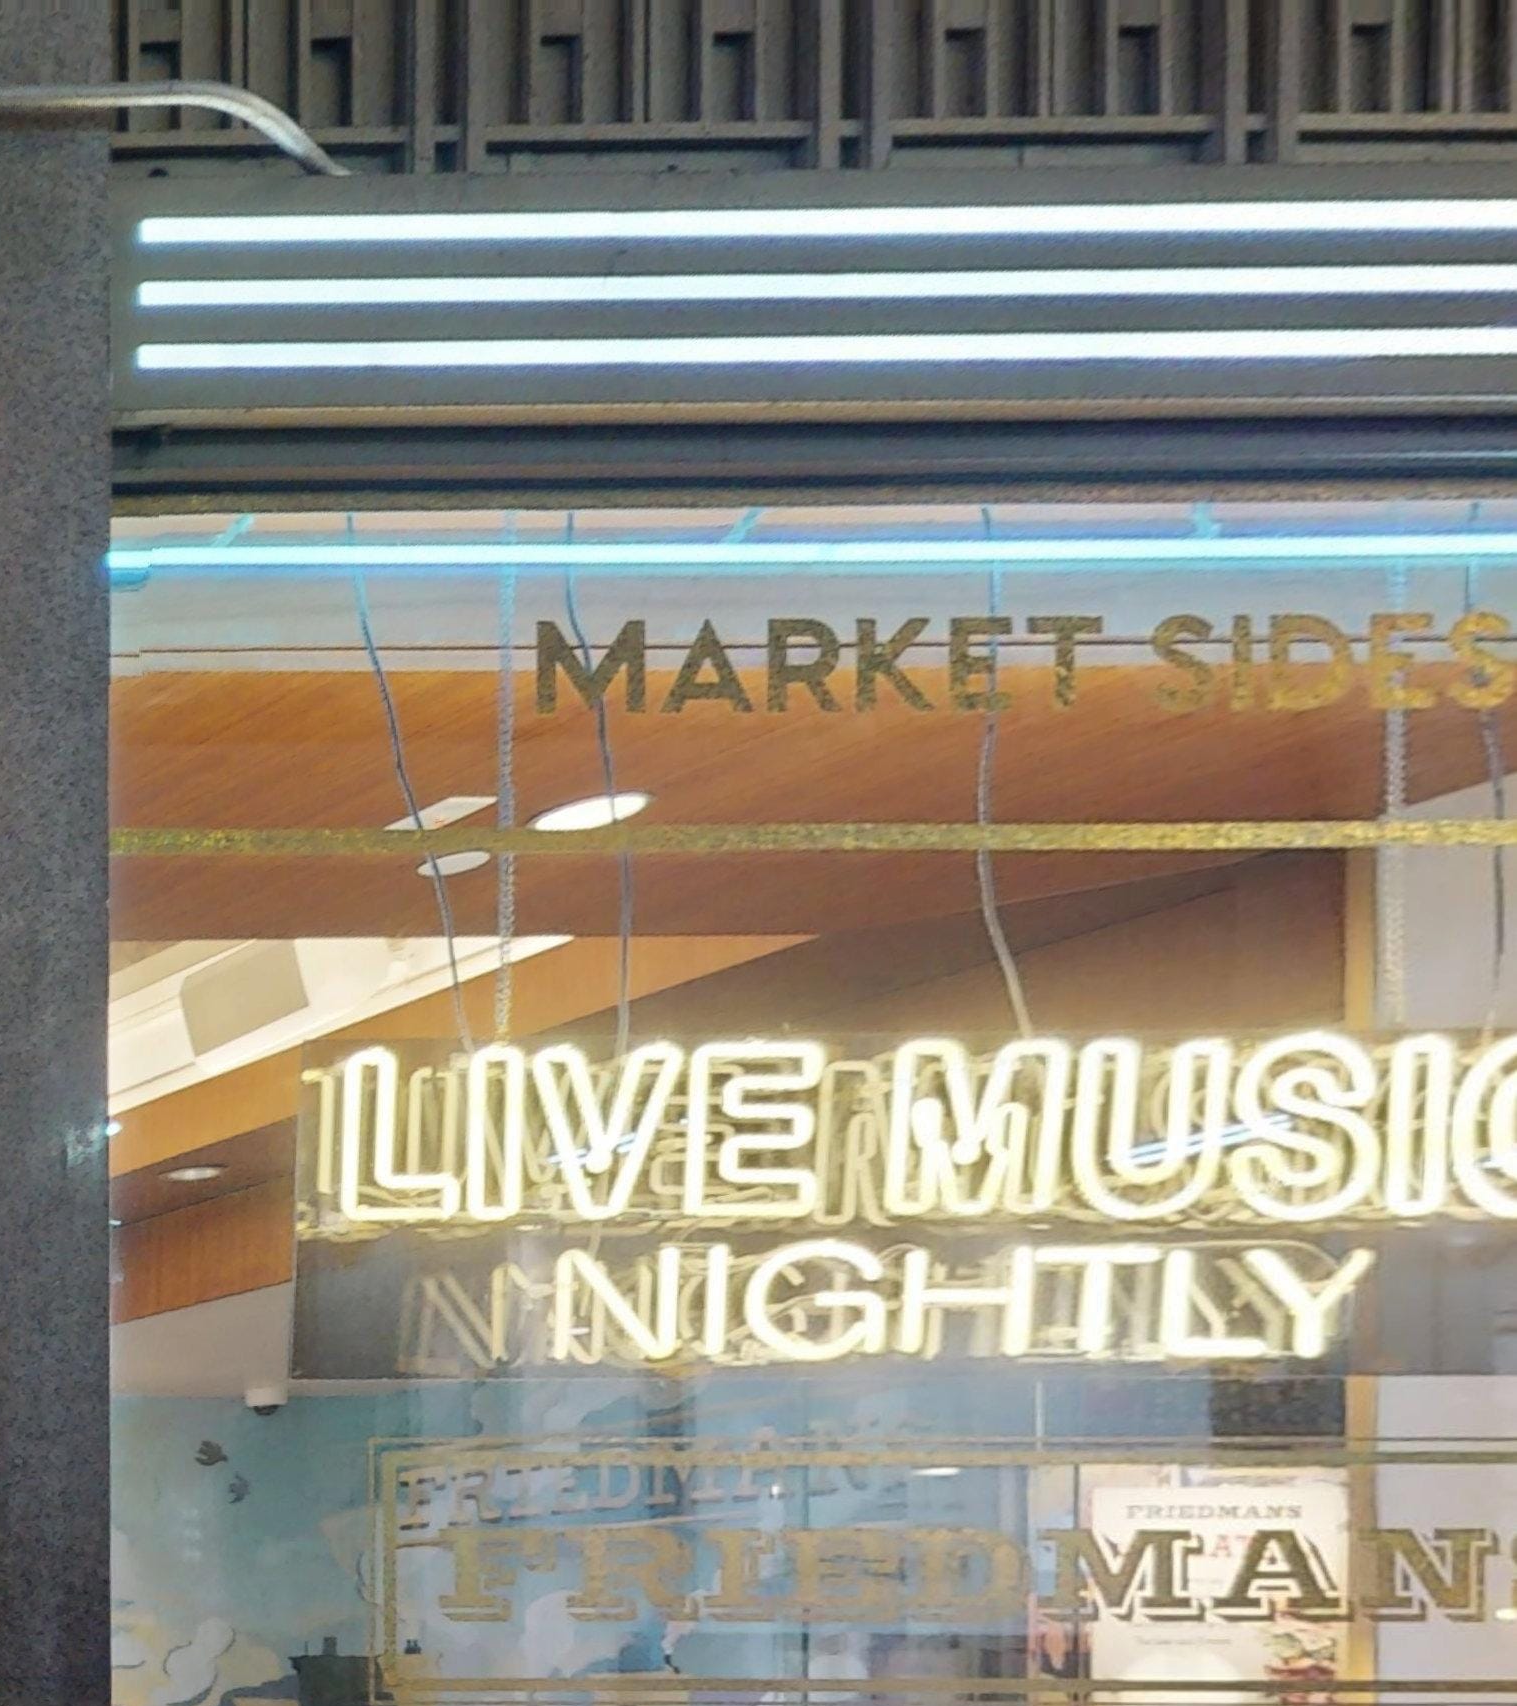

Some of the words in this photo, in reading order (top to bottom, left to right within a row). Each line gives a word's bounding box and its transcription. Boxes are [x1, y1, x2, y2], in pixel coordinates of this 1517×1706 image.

[533, 613, 1104, 715] MARKET
[1150, 611, 1515, 712] SIDES
[340, 1038, 826, 1222] LIVE
[552, 1238, 1377, 1363] NIGHTLY
[1125, 1504, 1303, 1520] FRIEDMANS
[438, 1526, 1517, 1624] FRIEDMAN
